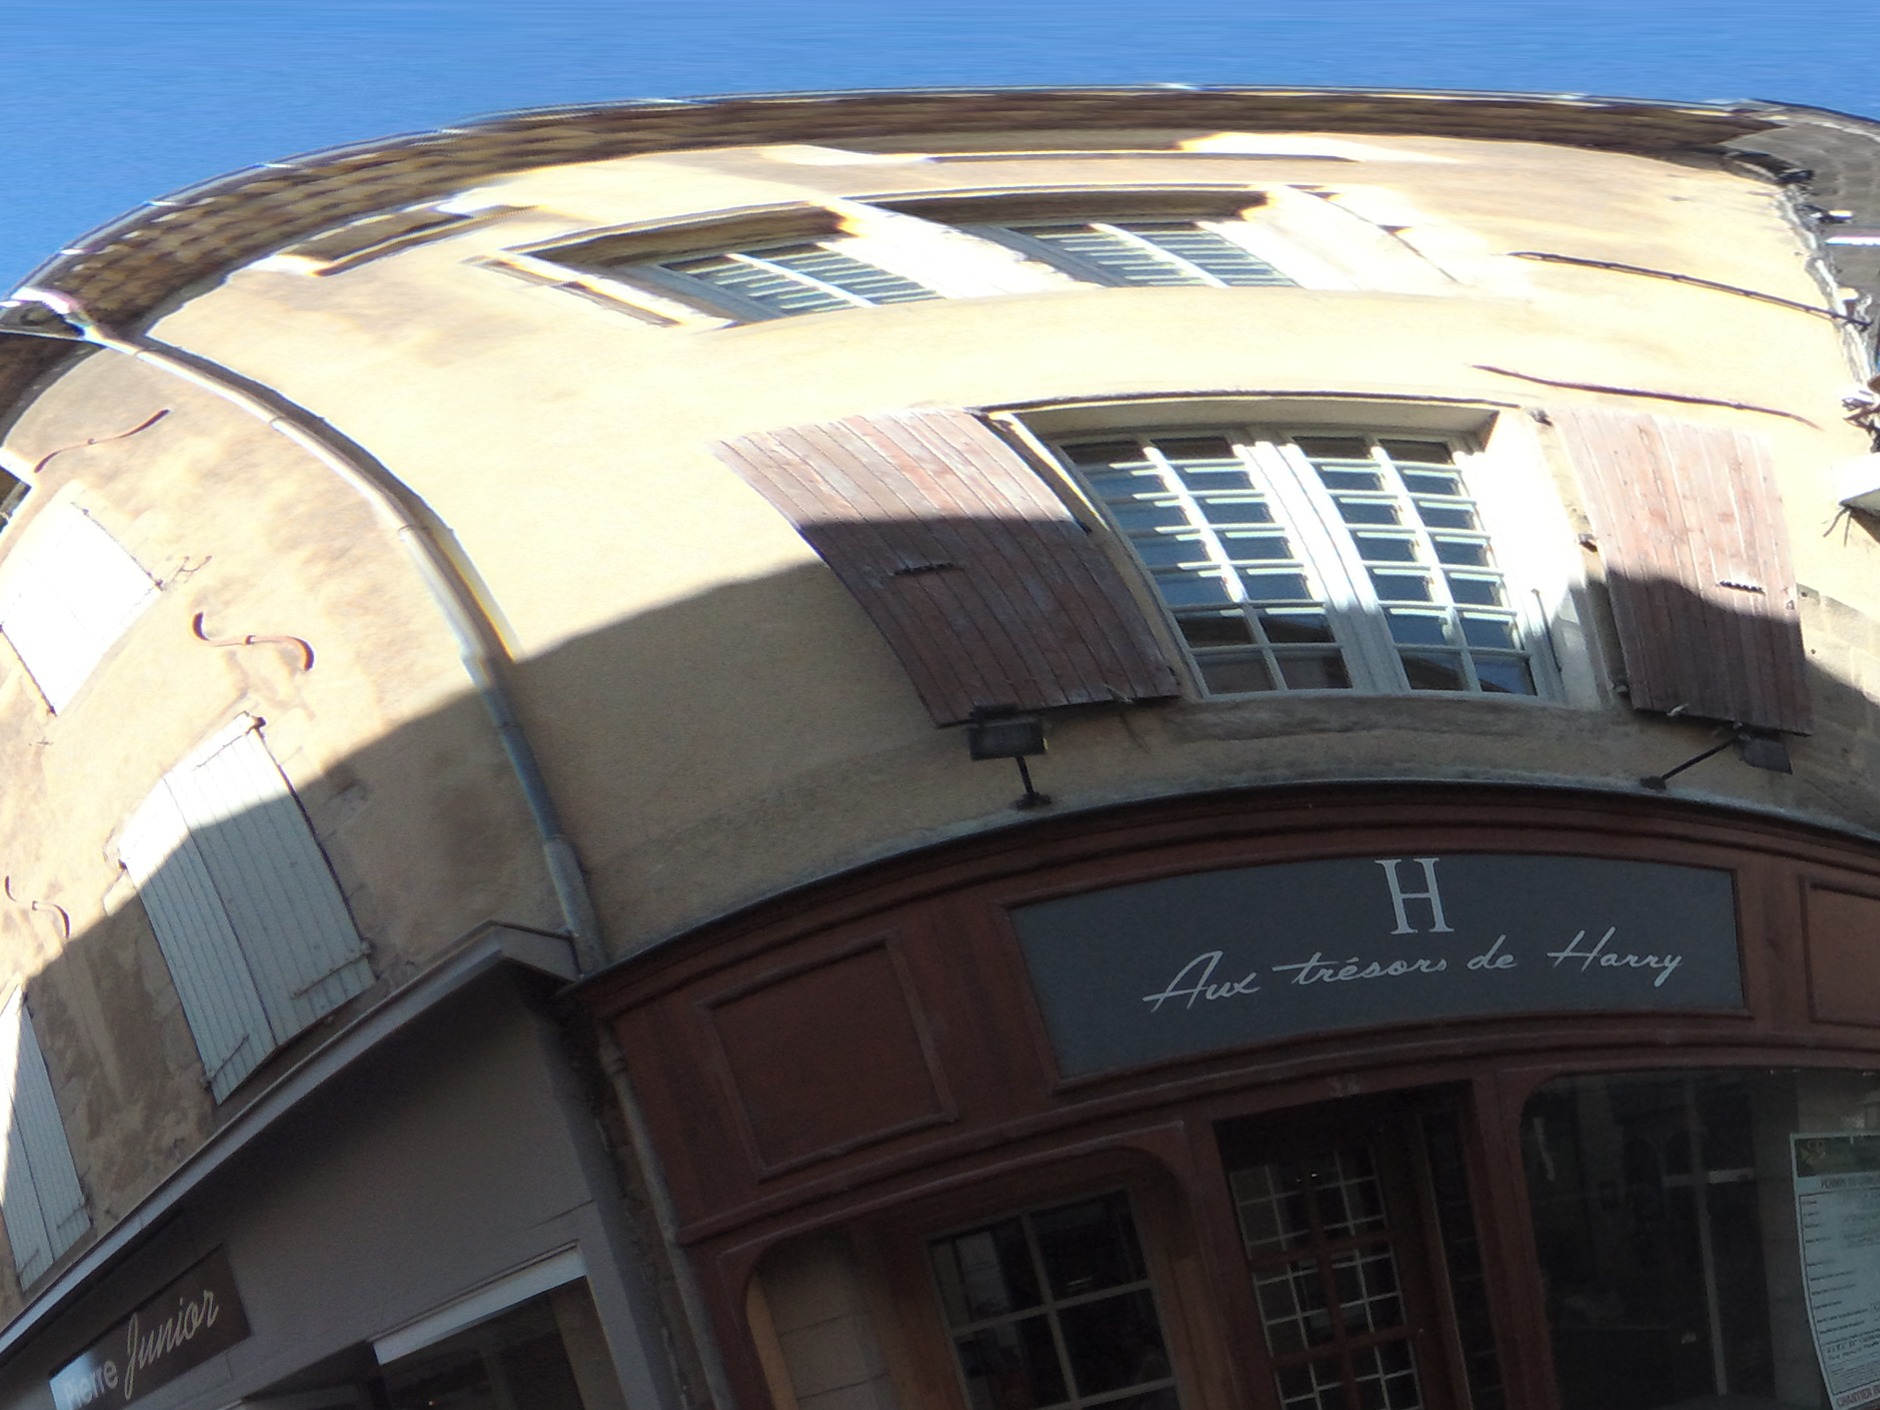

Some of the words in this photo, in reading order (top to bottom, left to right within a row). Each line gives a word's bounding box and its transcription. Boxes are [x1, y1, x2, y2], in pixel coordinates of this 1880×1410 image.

[1375, 856, 1456, 935] H
[1143, 949, 1261, 1013] Aux
[1273, 950, 1446, 986] trésors
[1466, 934, 1518, 972] de
[1548, 926, 1684, 988] Harry
[124, 1289, 219, 1401] Junior
